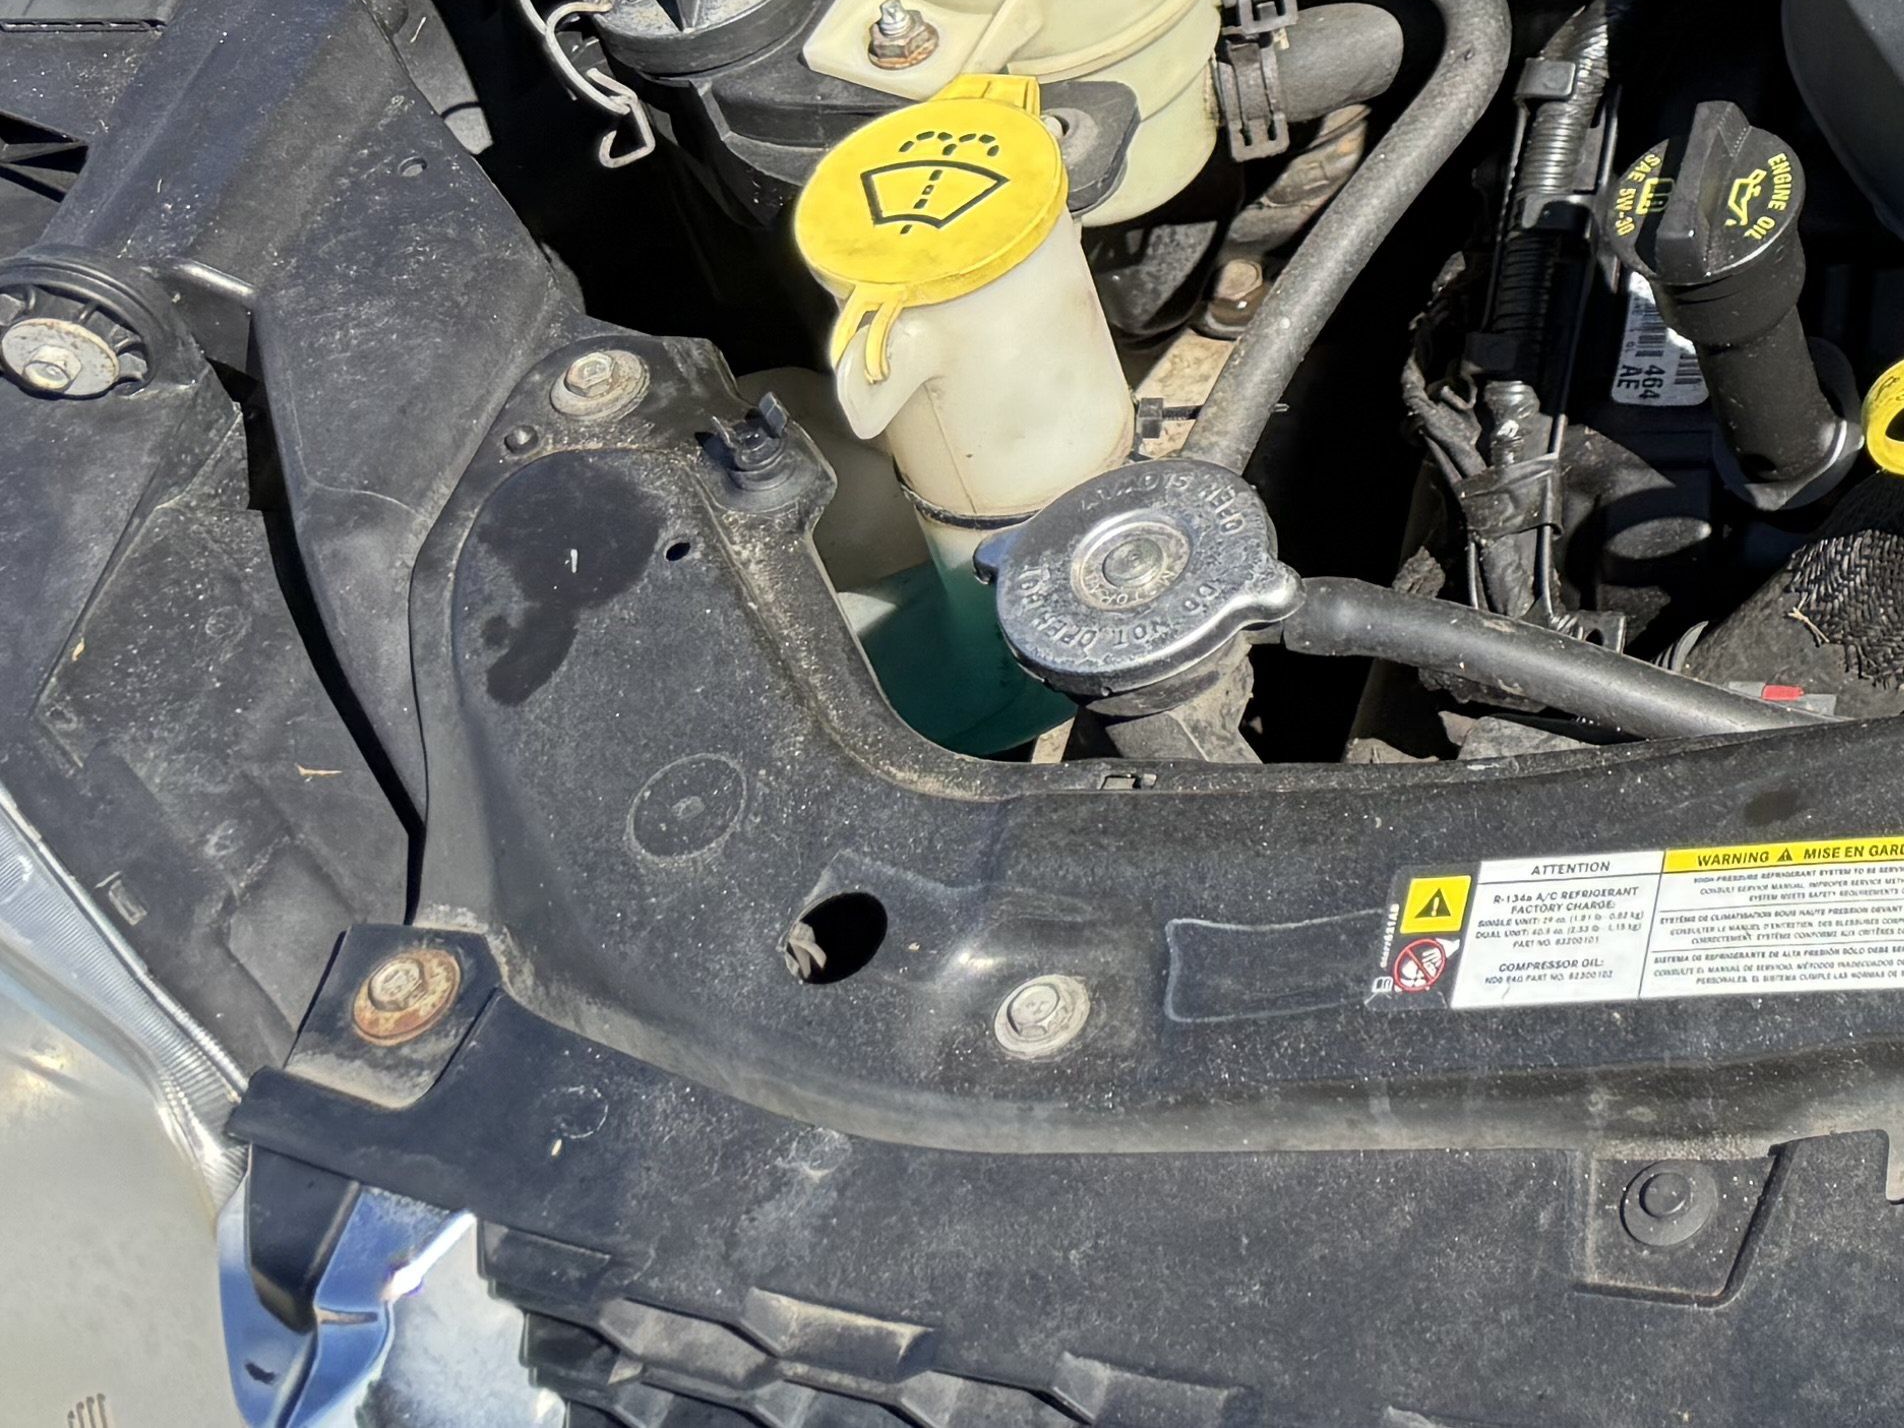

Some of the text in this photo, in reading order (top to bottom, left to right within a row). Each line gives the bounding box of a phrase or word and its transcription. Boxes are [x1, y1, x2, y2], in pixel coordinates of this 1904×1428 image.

[1628, 153, 1661, 183] SAE
[1744, 153, 1792, 239] ENGINE OIL
[1617, 364, 1640, 390] AE
[1642, 363, 1665, 400] 464
[1696, 850, 1769, 866] WARNING
[1803, 846, 1840, 860] MISE
[1844, 845, 1864, 857] EN
[1530, 861, 1610, 875] ATTENTION
[1535, 891, 1558, 901] A/C
[1560, 886, 1639, 899] REFRIGERANT
[1510, 903, 1563, 914] FACTORY
[1498, 959, 1579, 972] COMPRESSOR
